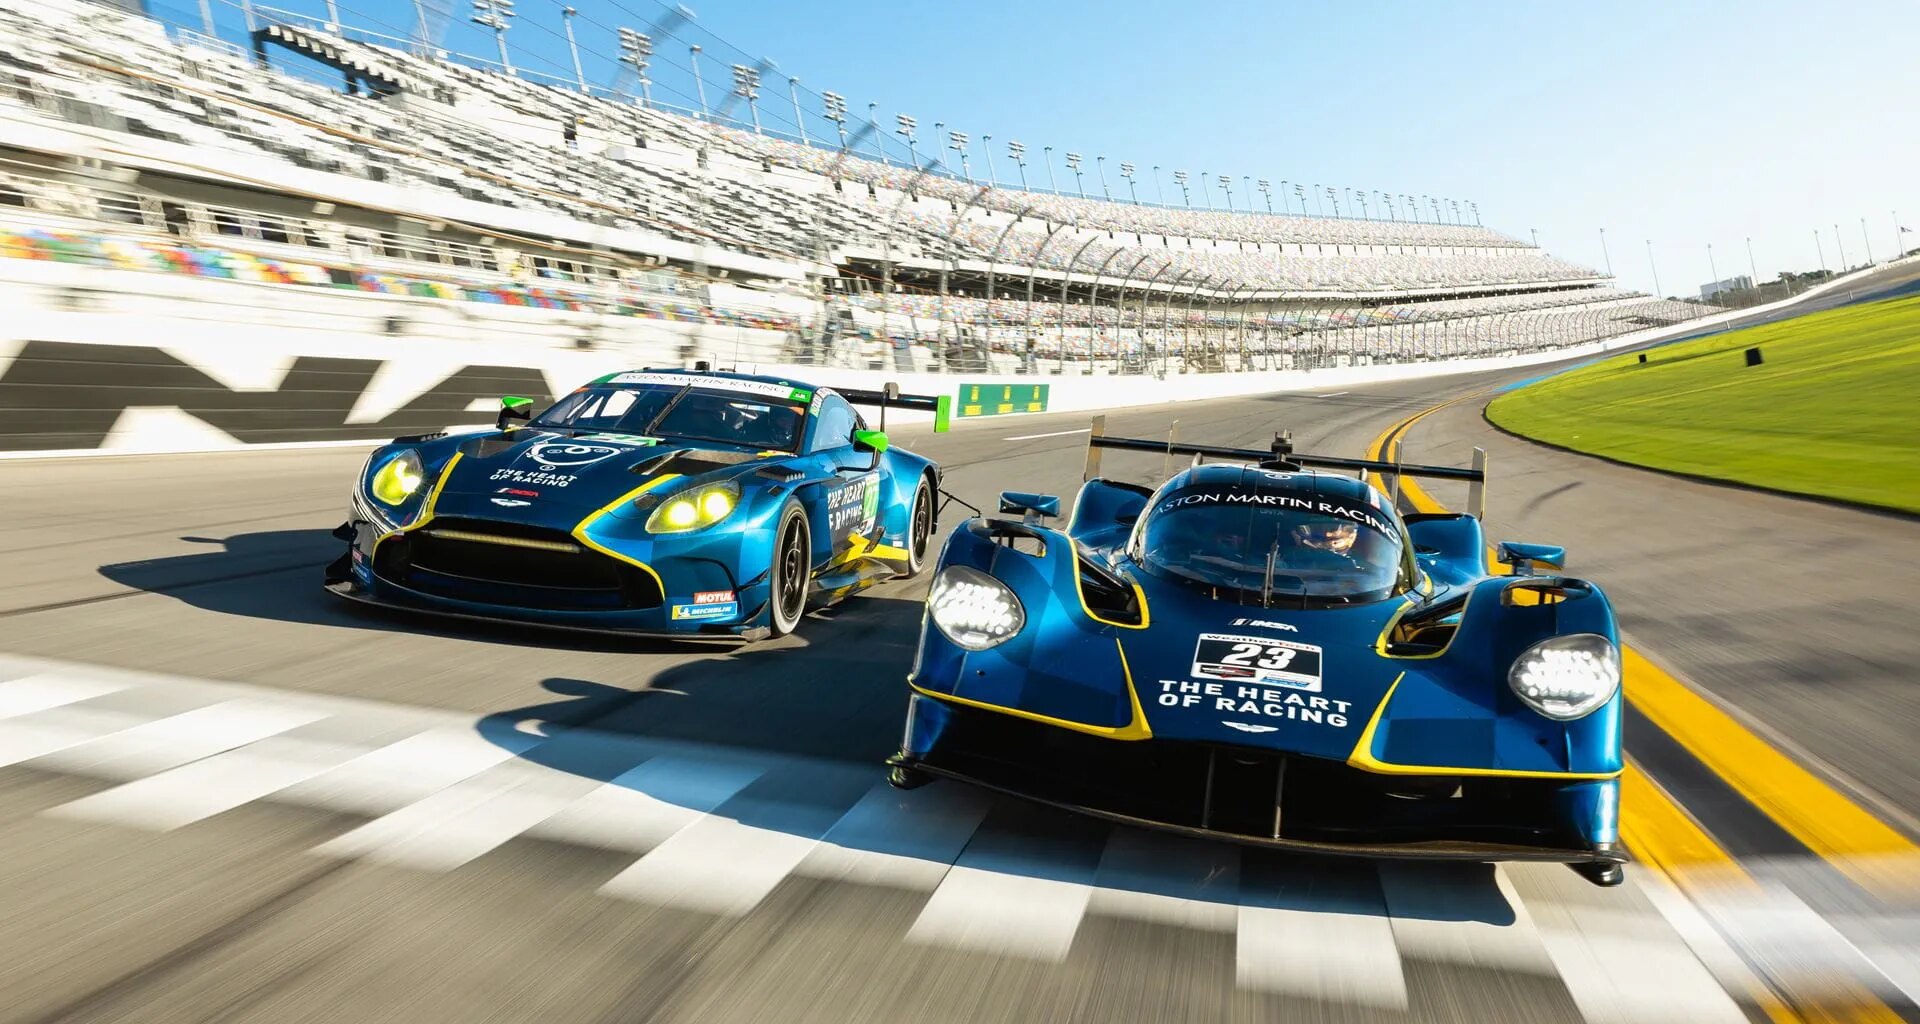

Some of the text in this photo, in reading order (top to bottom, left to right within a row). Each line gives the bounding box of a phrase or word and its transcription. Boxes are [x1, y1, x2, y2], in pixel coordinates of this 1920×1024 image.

[671, 376, 723, 386] MARTIN
[729, 382, 785, 393] RACING
[496, 468, 578, 482] THE HEART
[512, 475, 569, 487] RACING
[841, 481, 866, 505] HEART
[835, 504, 863, 531] RACING
[1226, 494, 1313, 509] MARTIN
[1318, 502, 1400, 545] RACING
[696, 592, 733, 603] MOTUL
[691, 606, 733, 615] MICHELIN
[1248, 619, 1299, 633] IMSA
[1220, 643, 1297, 670] 23
[1158, 680, 1352, 714] THE HEART
[1158, 693, 1348, 728] OF RACING
